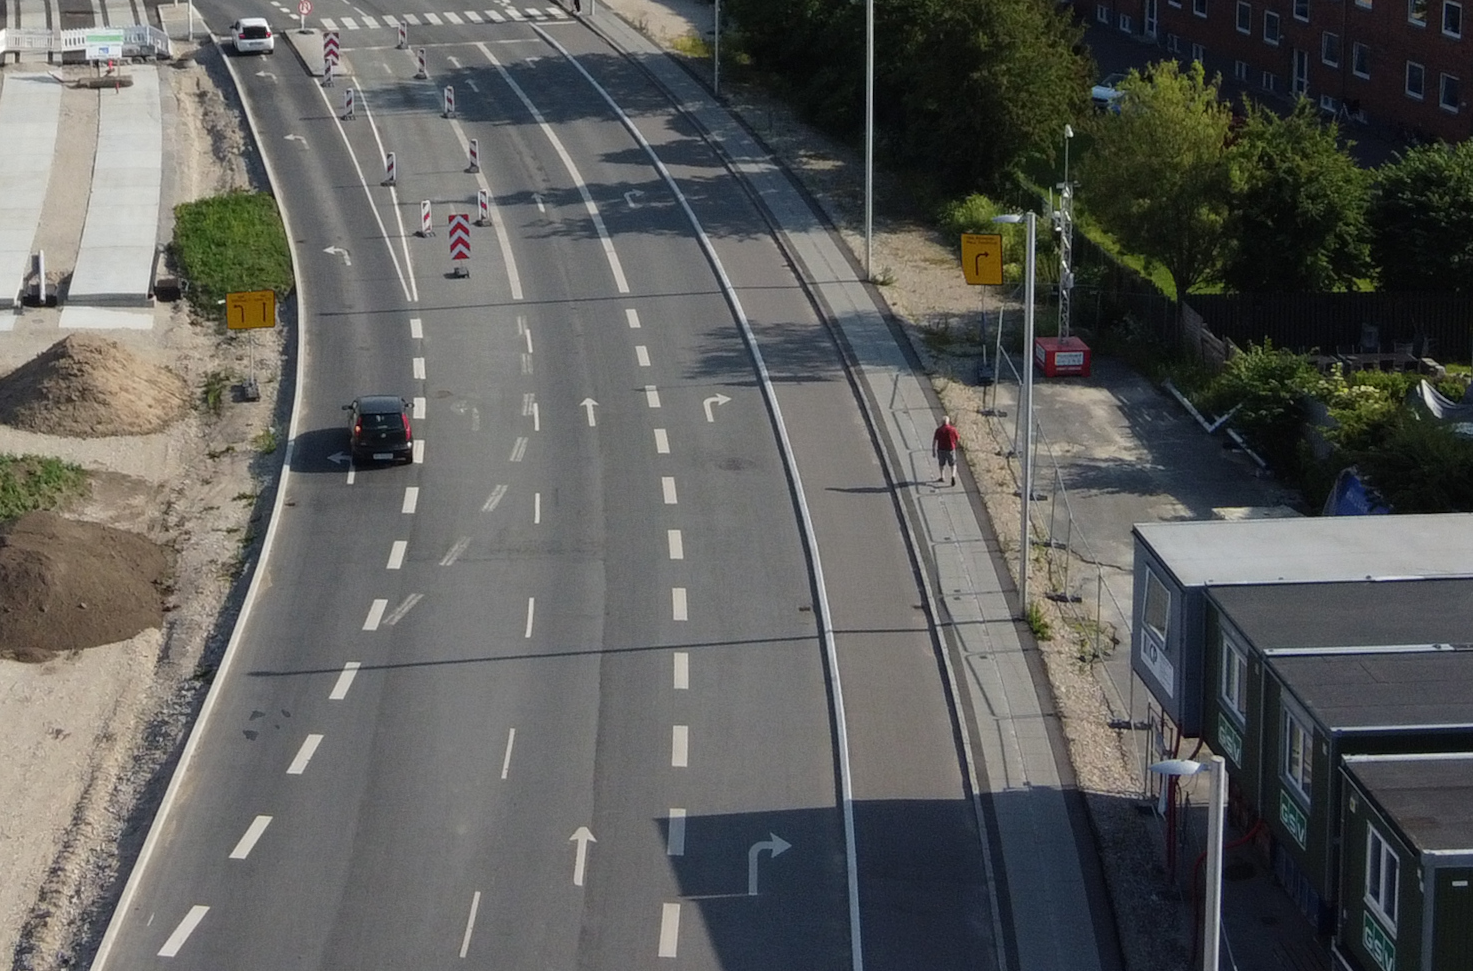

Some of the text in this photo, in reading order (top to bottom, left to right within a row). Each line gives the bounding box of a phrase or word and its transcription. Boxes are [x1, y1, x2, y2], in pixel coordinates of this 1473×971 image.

[1219, 725, 1240, 761] GSV
[1281, 803, 1305, 843] GSV
[1365, 926, 1393, 971] GSV
